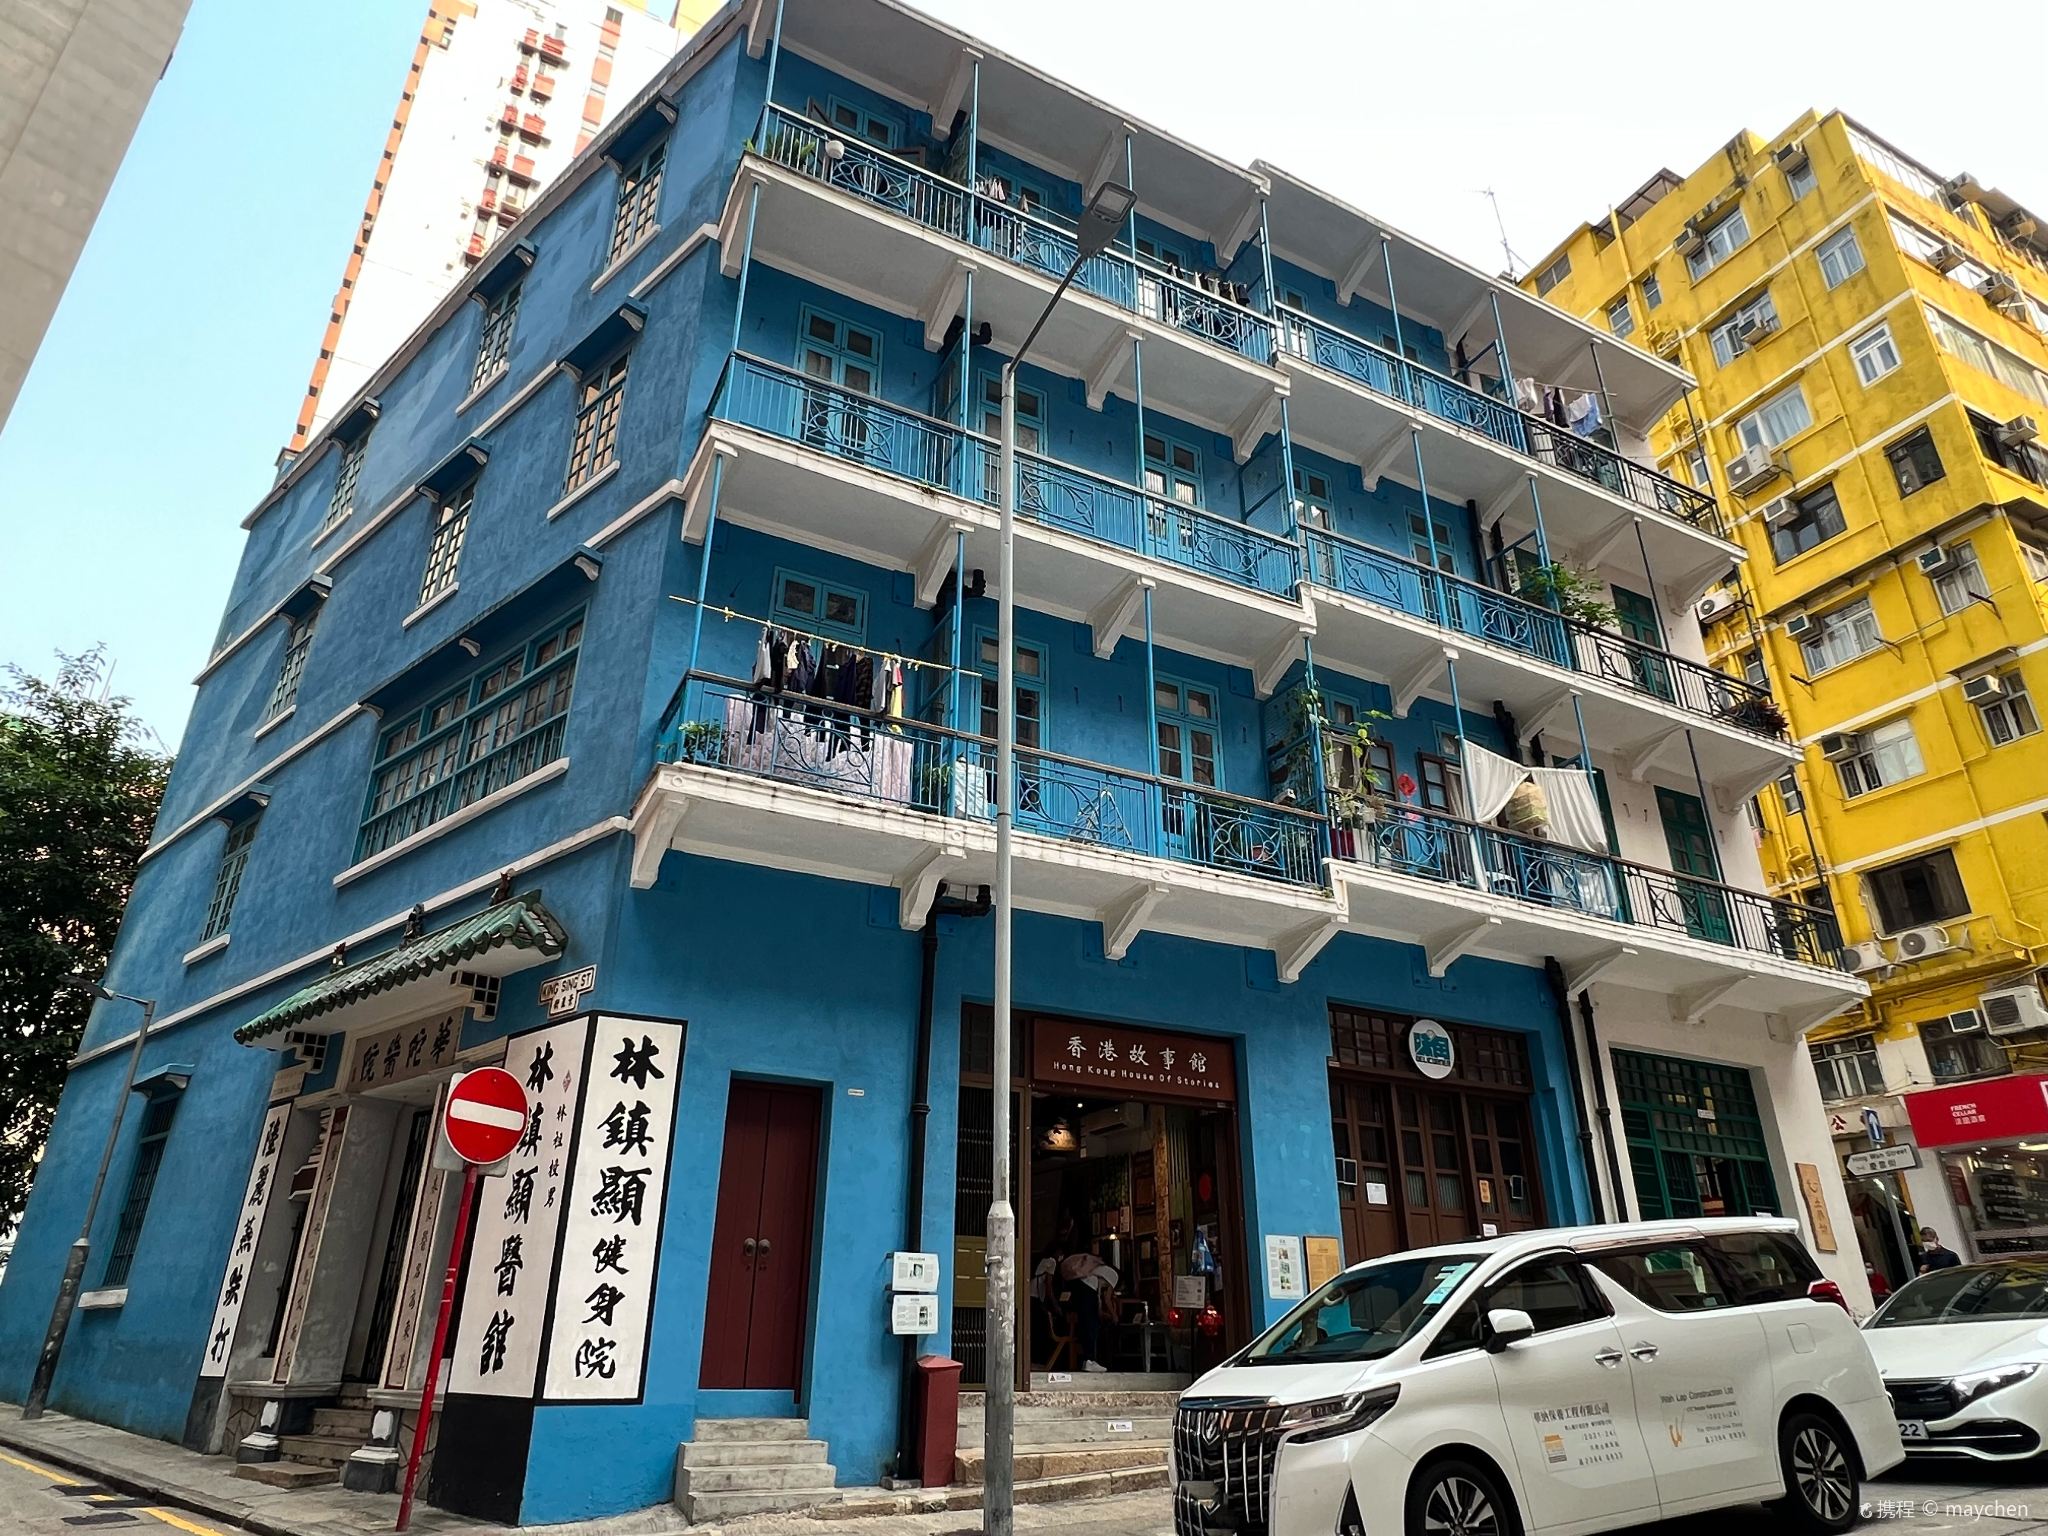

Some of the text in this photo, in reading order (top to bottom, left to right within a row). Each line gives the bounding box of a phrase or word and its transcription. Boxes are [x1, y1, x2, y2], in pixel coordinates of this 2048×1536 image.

[561, 976, 578, 993] SING
[581, 972, 592, 987] ST
[1066, 1036, 1208, 1073] 香港故事館
[1053, 1061, 1220, 1089] Hong Kong House Of Stories
[1950, 1103, 1977, 1112] FRENCH
[1952, 1109, 1977, 1118] CELLAR
[1885, 1148, 1907, 1157] Street
[575, 1035, 665, 1380] 林鎮顯健身院
